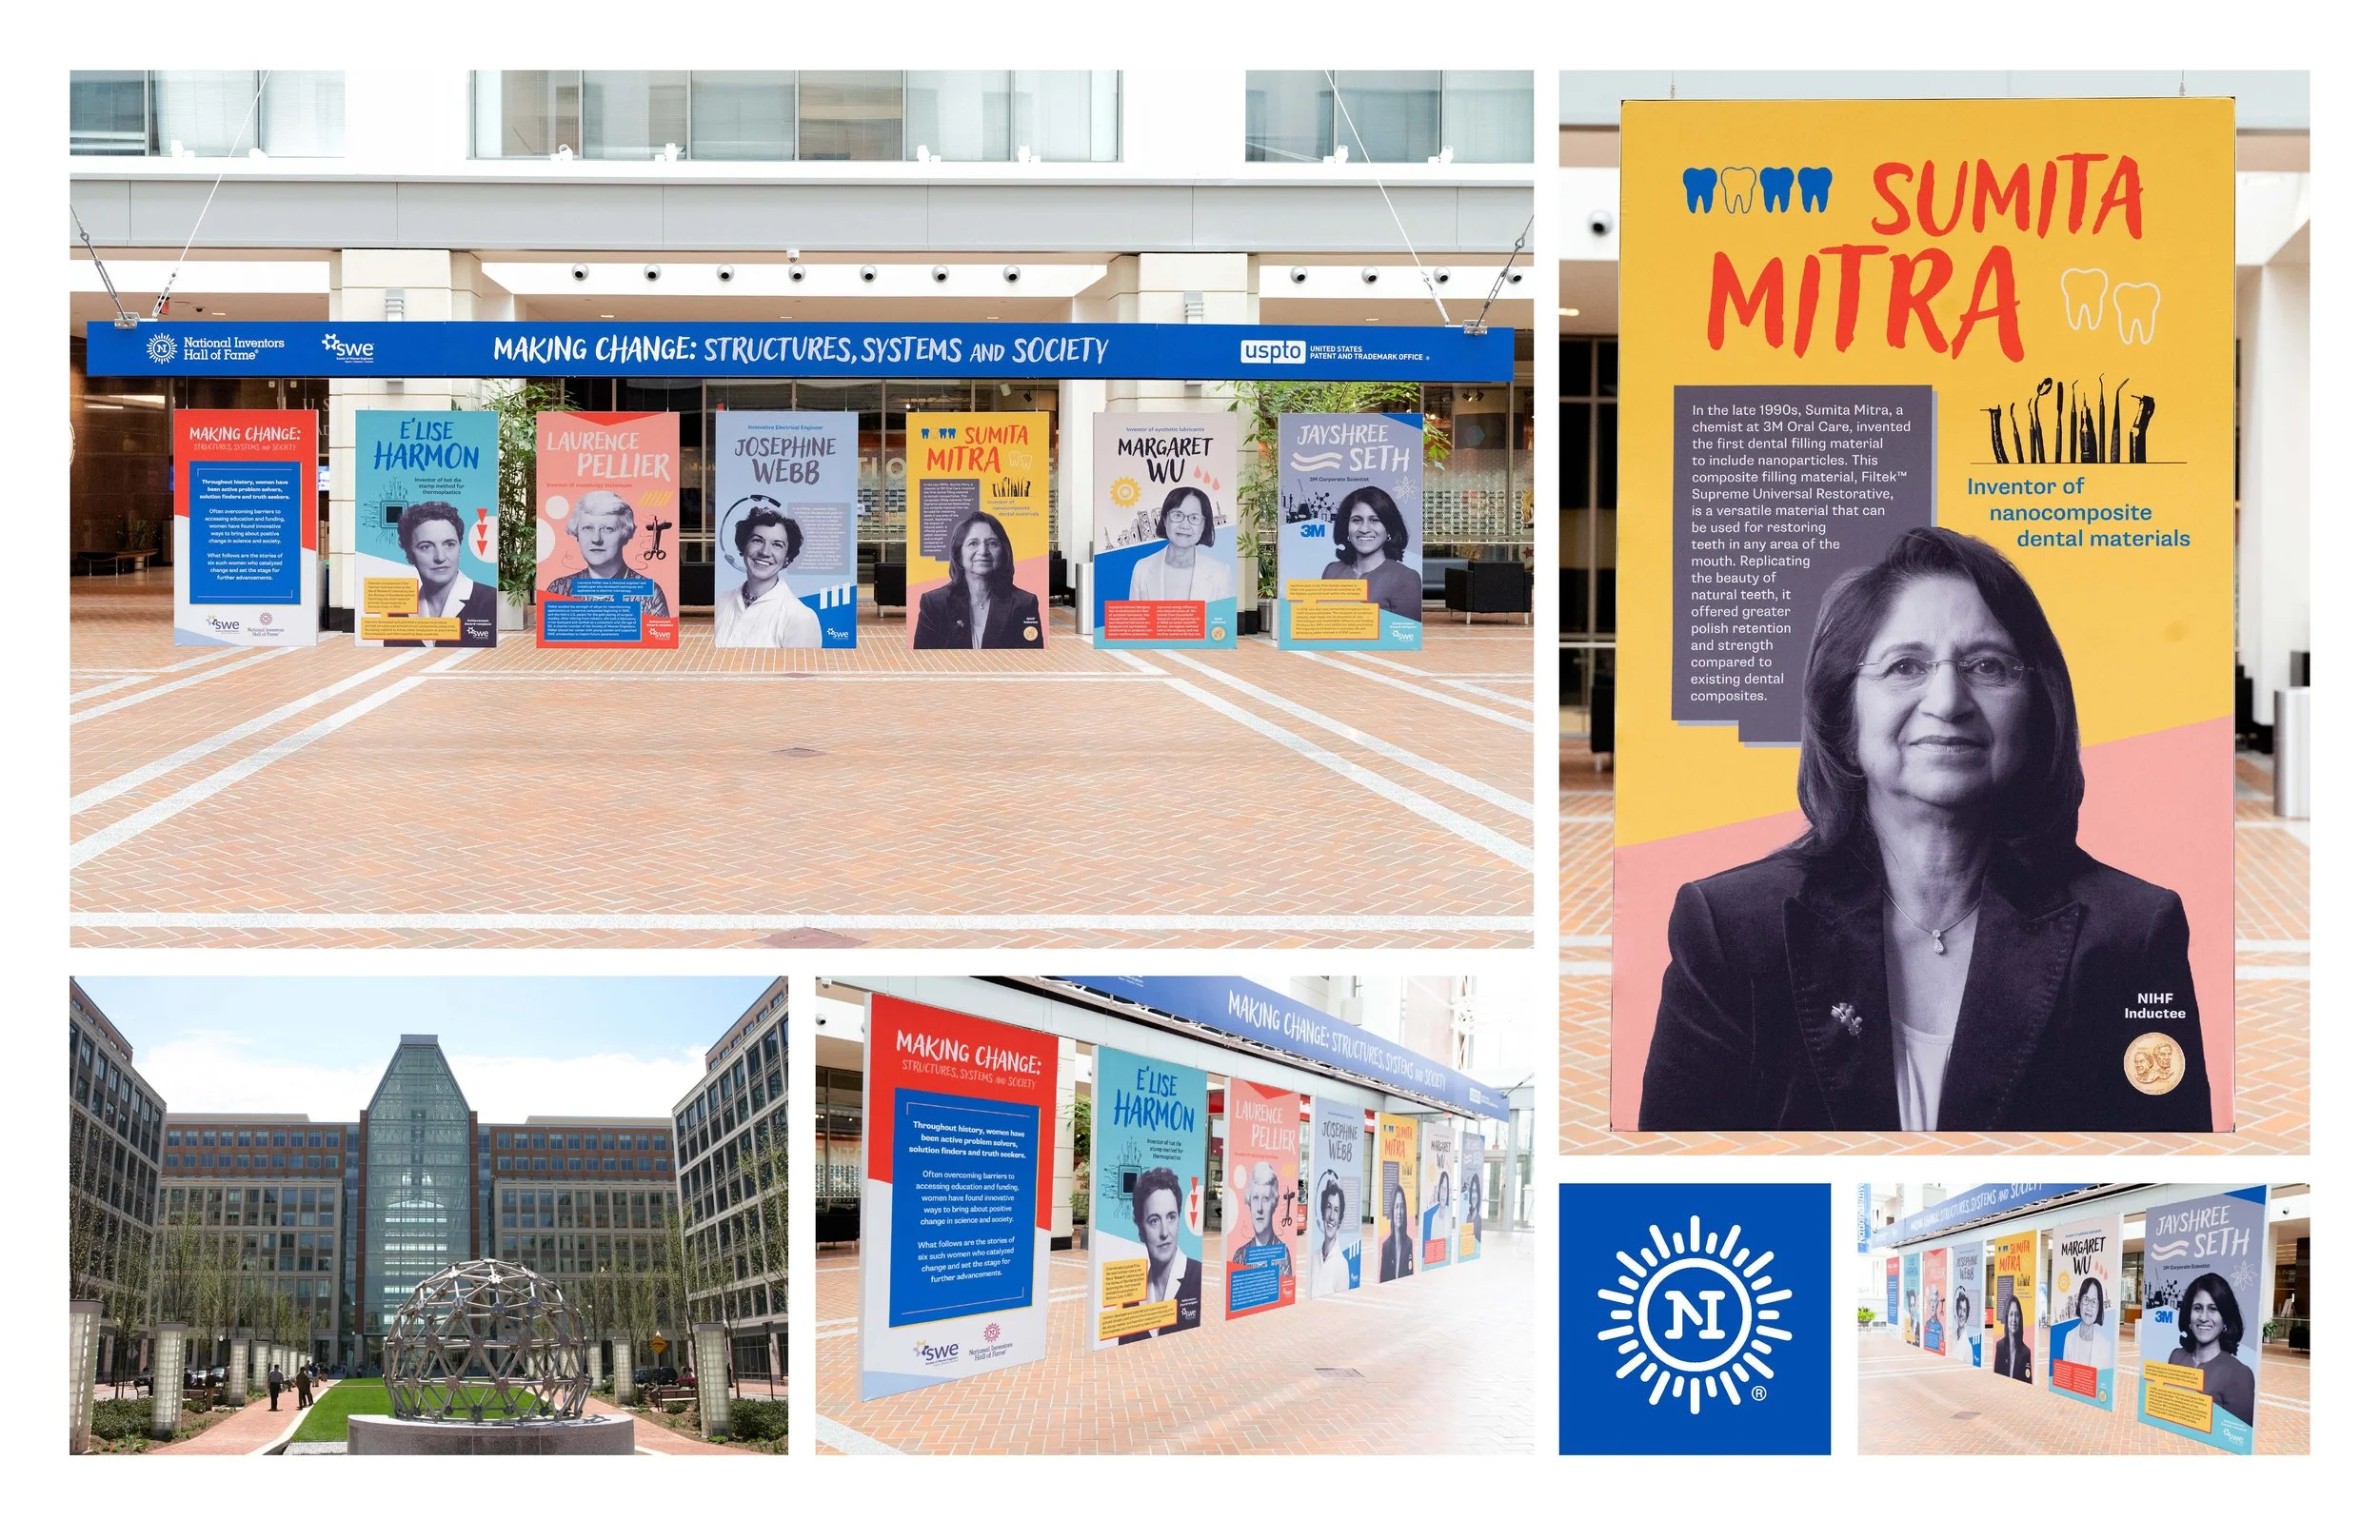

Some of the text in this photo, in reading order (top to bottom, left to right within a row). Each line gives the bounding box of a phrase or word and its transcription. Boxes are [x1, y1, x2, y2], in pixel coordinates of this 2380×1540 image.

[1872, 152, 2144, 240] SUMITA
[1708, 244, 2024, 363] MITRA
[185, 337, 285, 348] National Inventors
[337, 343, 373, 356] swe
[494, 335, 1108, 364] MAKING CHANGE: STRUCTURES, SYSTEMS AND SOCIETY
[184, 349, 208, 360] Hall
[211, 349, 221, 360] of
[1246, 342, 1300, 363] uspto
[1694, 405, 1703, 415] In
[1708, 405, 1728, 415] the
[1733, 405, 1755, 415] late
[1759, 405, 1801, 417] 1990s,
[1806, 405, 1850, 415] Sumita
[1854, 405, 1892, 417] Mitra,
[190, 426, 301, 442] MAKING CHANGE:
[964, 424, 1028, 445] SUMITA
[1298, 423, 1388, 445] JAYSHREE
[1693, 421, 1910, 434] chemist at 3M Oral Care, invented
[546, 431, 640, 452] LAURENCE
[735, 436, 836, 459] JOSEPHINE
[1119, 438, 1213, 458] MARGARET
[1693, 438, 1883, 451] the first dental filling material
[374, 441, 479, 471] HARMON
[926, 446, 1001, 473] MITRA
[1350, 445, 1409, 472] SETH
[1693, 454, 1877, 467] to include nanoparticles. This
[577, 452, 670, 483] PELLIER
[752, 459, 820, 484] WEBB
[1146, 459, 1185, 484] WU
[1693, 472, 1757, 484] composite
[1762, 471, 1796, 484] filling
[1801, 471, 1856, 484] material,
[1969, 477, 2085, 495] Inventor of
[1693, 488, 1893, 502] Supreme Universal Restorative,
[1693, 505, 1701, 516] is
[1717, 504, 1771, 516] versatile
[1776, 504, 1828, 515] material
[1832, 504, 1858, 515] that
[1991, 504, 2152, 524] nanocomposite
[1300, 524, 1325, 538] 3M
[1693, 522, 1826, 535] be used for restoring
[2017, 529, 2190, 546] dental materials
[1692, 539, 1725, 549] teeth
[1730, 539, 1739, 549] in
[1744, 542, 1766, 552] any
[1802, 538, 1815, 549] of
[1819, 539, 1839, 549] the
[1692, 555, 1810, 568] mouth. Replicating
[1692, 572, 1776, 585] the beauty of
[1692, 588, 1791, 602] natural teeth, it
[1692, 605, 1790, 619] offered greater
[1692, 622, 1791, 636] polish retention
[1691, 640, 1773, 653] and strength
[1691, 657, 1772, 670] compared to
[1691, 673, 1783, 687] existing dental
[1691, 691, 1767, 703] composites.
[2138, 994, 2172, 1003] NIHF
[2125, 1008, 2186, 1018] Inductee
[1228, 990, 1279, 1031] MAKING
[1284, 1013, 1330, 1048] CHANGE:
[1332, 1032, 1385, 1070] STRUCTURES,
[1385, 1053, 1414, 1080] SYSTEMS
[1424, 1069, 1446, 1092] SOCIETY
[896, 1030, 1041, 1075] MAKING CHANGE:
[902, 1059, 959, 1078] STRUCTURES,
[960, 1069, 993, 1083] SYSTEMS
[1008, 1076, 1036, 1090] SOCIETY
[1114, 1089, 1195, 1133] HARMON
[1235, 1099, 1283, 1124] LAURENCE
[913, 1121, 957, 1132] Throughout
[959, 1125, 984, 1135] history,
[1322, 1121, 1358, 1141] JOSEPHINE
[1251, 1123, 1296, 1155] PELLIER
[1328, 1139, 1353, 1162] WEBB
[1385, 1139, 1406, 1158] MITRA
[2156, 1205, 2231, 1235] JAYSHREE
[2010, 1239, 2031, 1254] SUMITA
[2061, 1236, 2106, 1256] MARGARET
[2194, 1228, 2250, 1258] SETH
[1999, 1254, 2021, 1273] MITRA
[2073, 1256, 2092, 1275] WU
[2154, 1310, 2173, 1324] 3M
